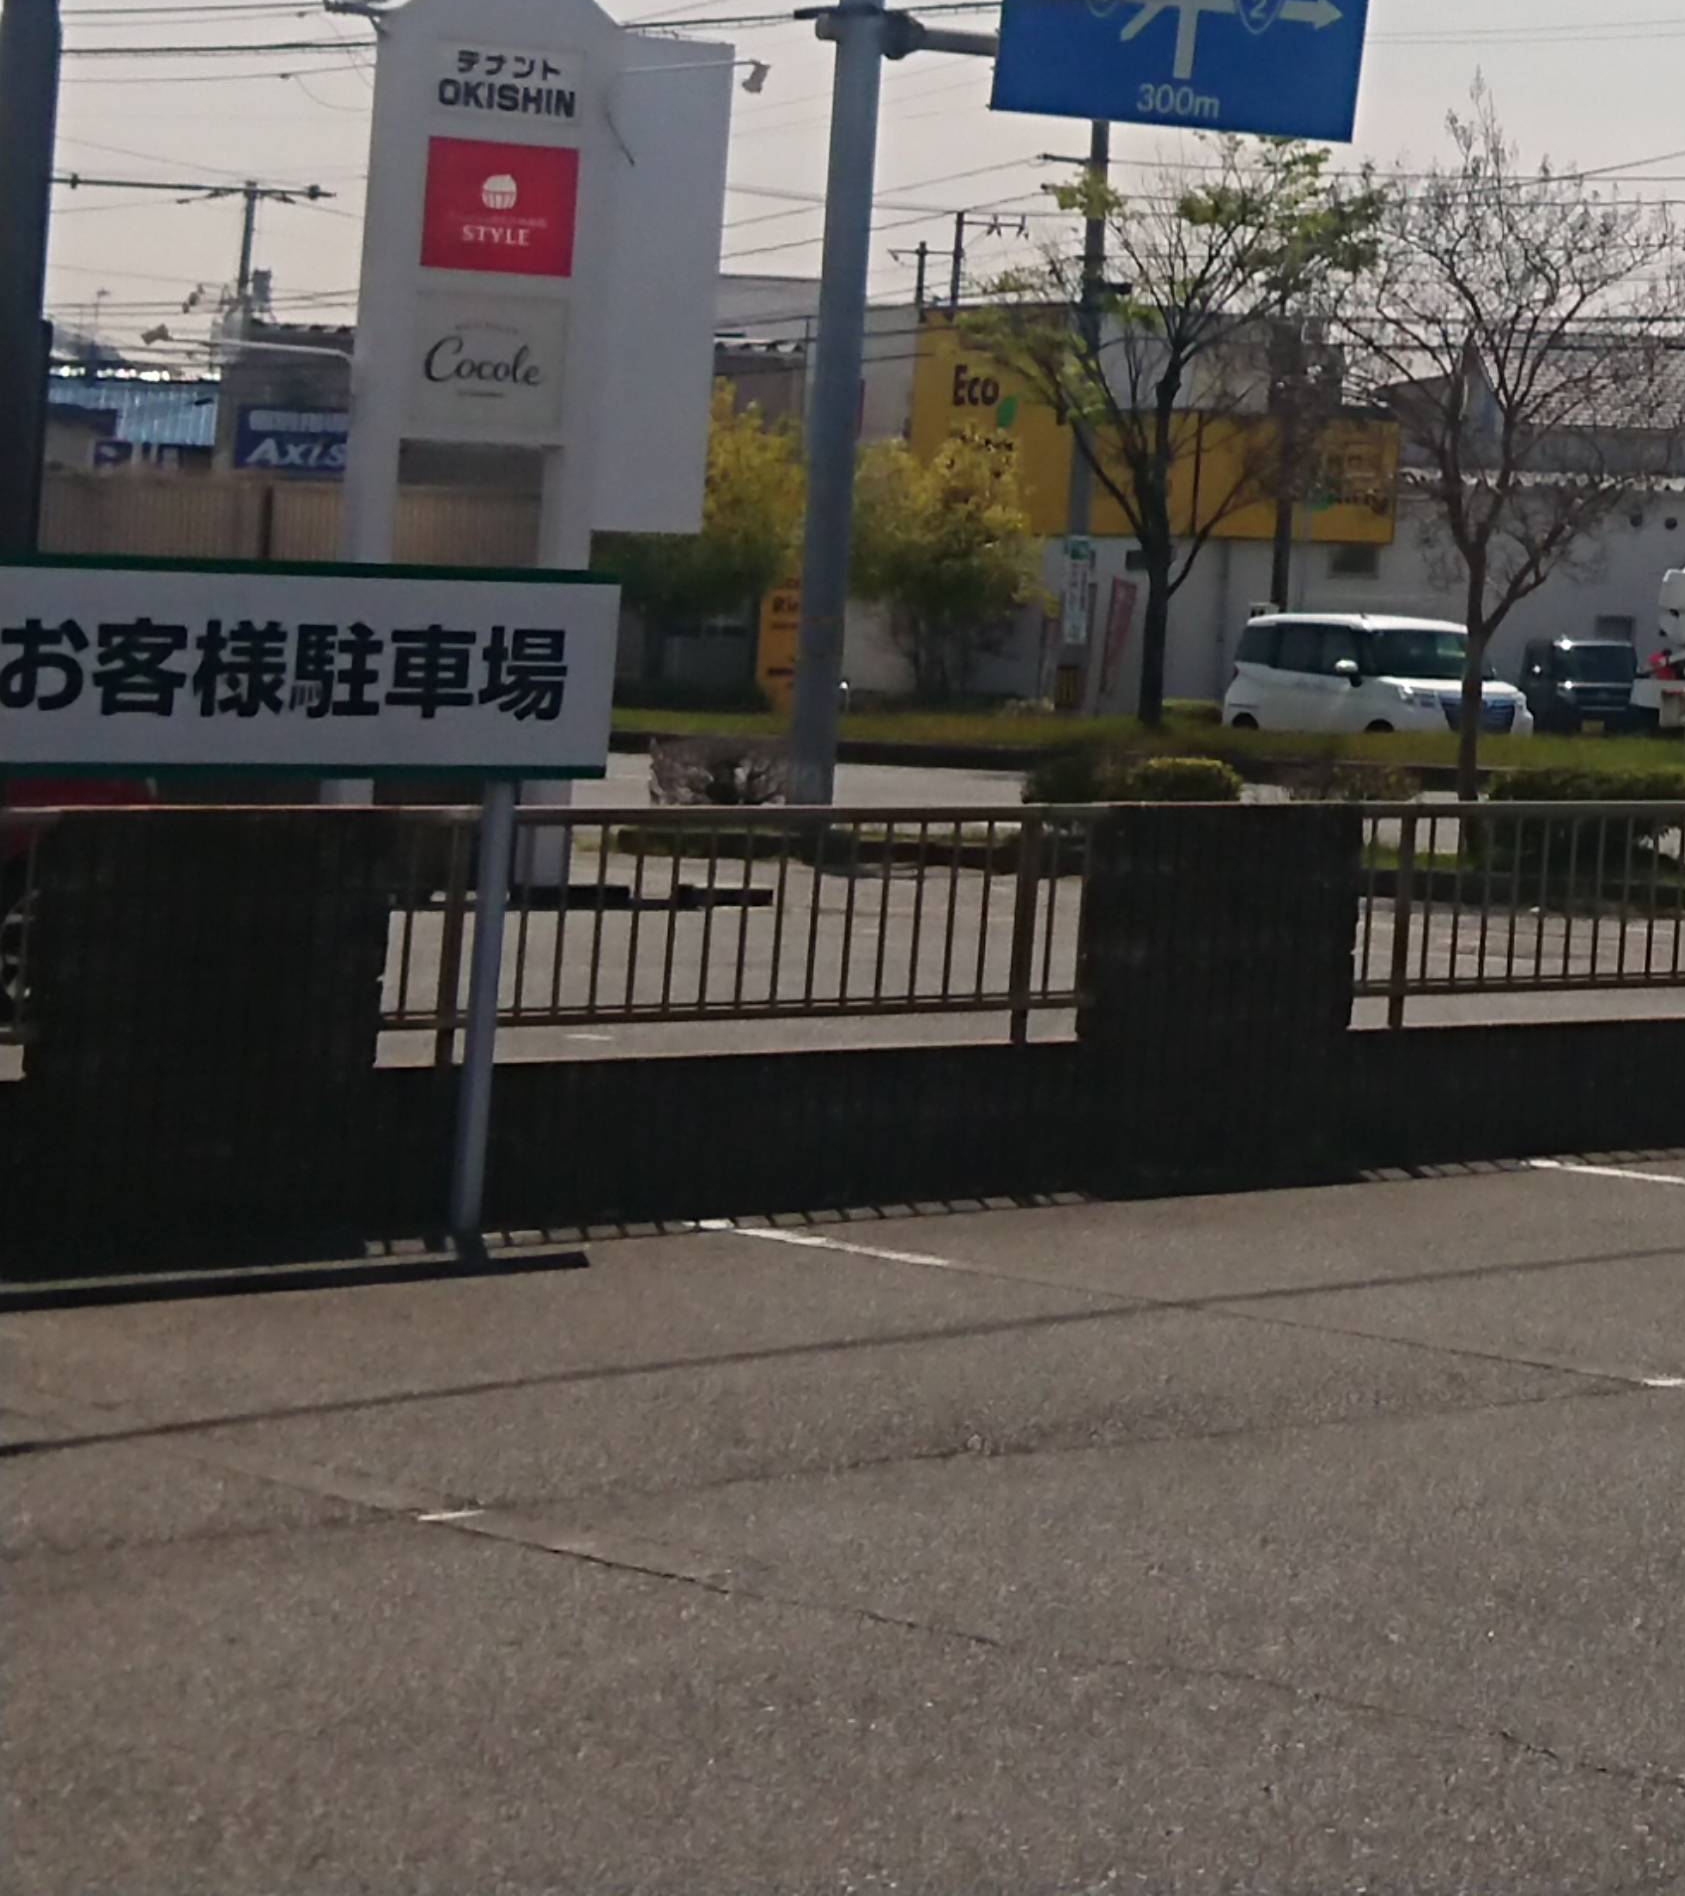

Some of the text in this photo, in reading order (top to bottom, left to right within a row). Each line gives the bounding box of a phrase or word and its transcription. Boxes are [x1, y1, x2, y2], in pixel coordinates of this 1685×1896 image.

[456, 49, 562, 82] テナント
[437, 76, 577, 120] OKISHIN
[1136, 83, 1221, 120] 300m
[461, 224, 532, 248] STYLE
[423, 334, 543, 388] Cocole
[951, 363, 1001, 407] Eco
[0, 615, 569, 722] お客様駐車場
